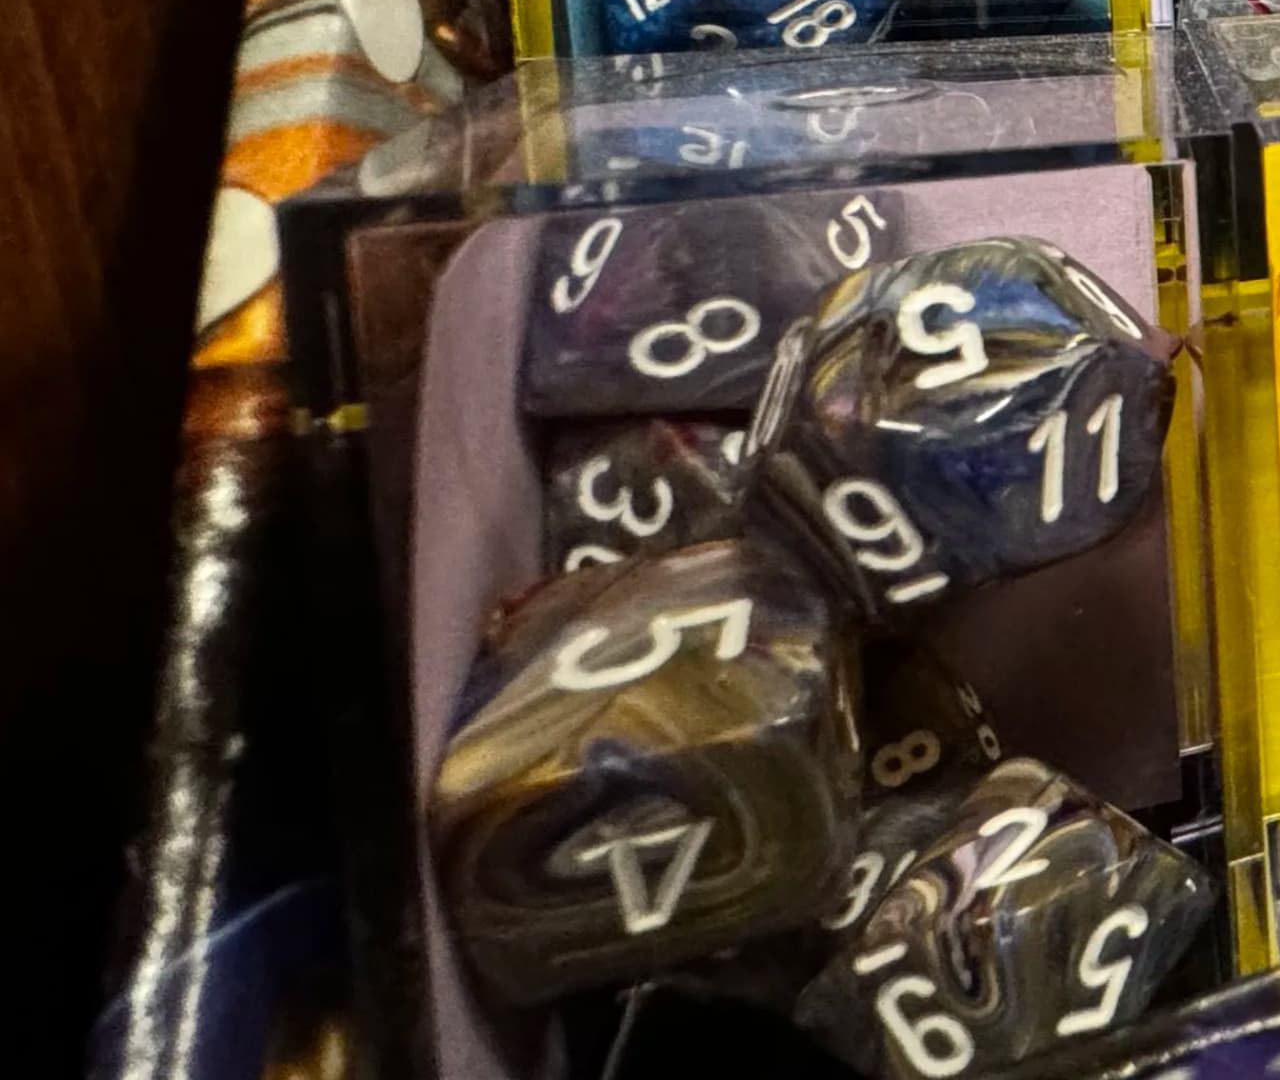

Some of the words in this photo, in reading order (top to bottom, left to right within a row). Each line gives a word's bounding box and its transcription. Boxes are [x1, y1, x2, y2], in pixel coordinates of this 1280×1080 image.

[826, 192, 888, 270] 5
[628, 295, 762, 379] 8
[896, 281, 990, 390] 5
[577, 454, 674, 537] 3
[1026, 392, 1124, 524] 11
[822, 476, 924, 572] 9
[549, 597, 754, 691] 5
[871, 728, 942, 788] 8
[574, 818, 716, 935] 4
[976, 806, 1051, 890] 2
[1055, 905, 1150, 1037] 5
